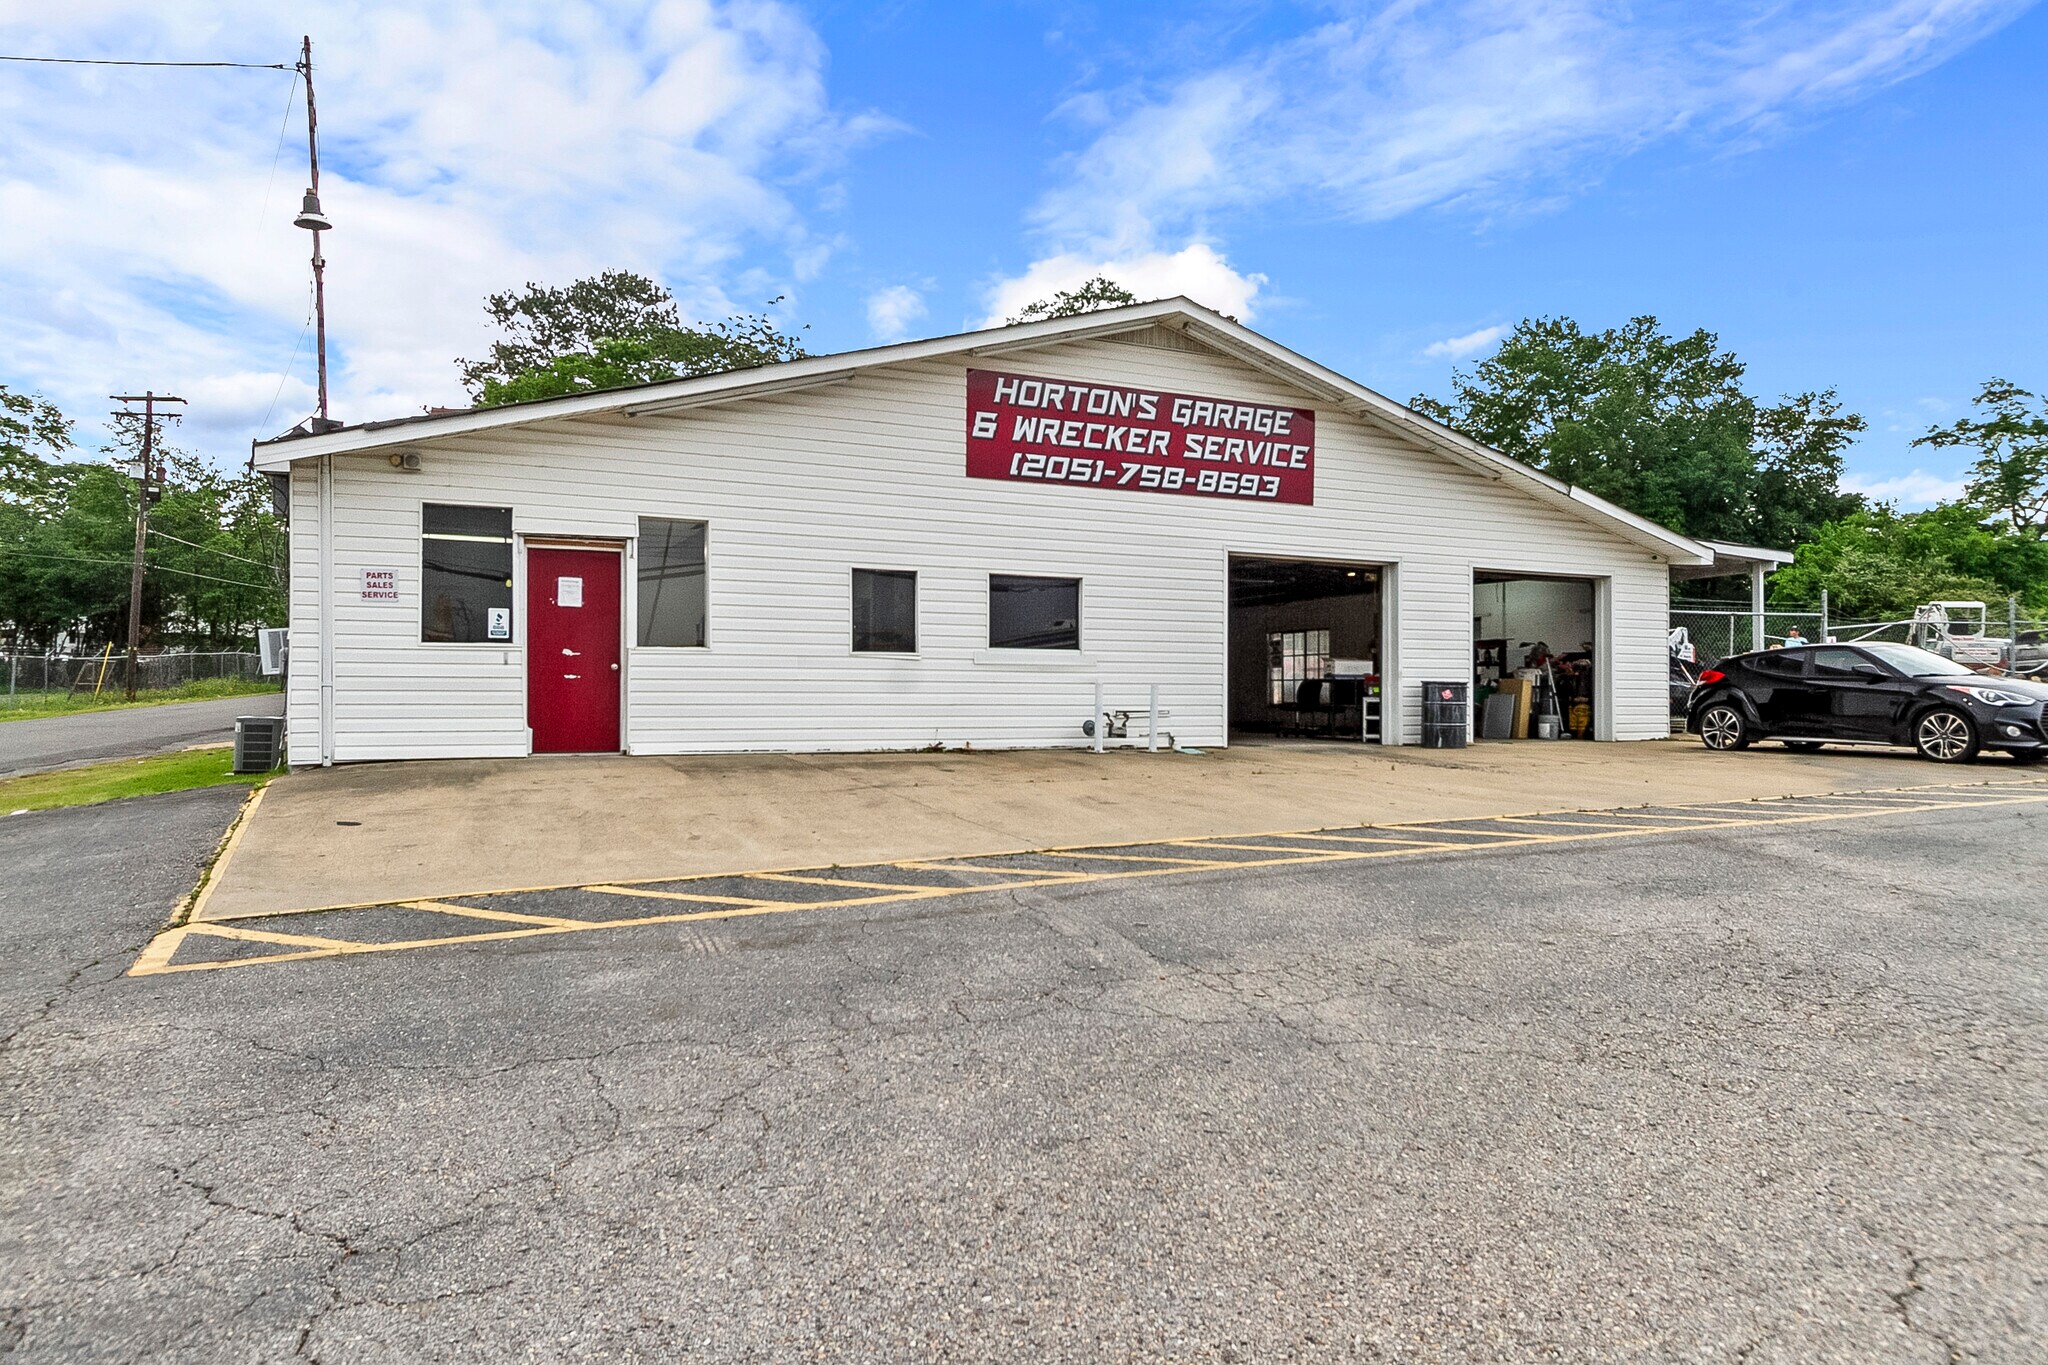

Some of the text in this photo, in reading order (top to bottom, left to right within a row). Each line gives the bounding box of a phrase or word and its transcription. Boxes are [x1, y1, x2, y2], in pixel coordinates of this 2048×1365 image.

[993, 377, 1294, 437] HORTON'S GARAGE
[1011, 415, 1171, 456] WRECKER
[1183, 433, 1310, 469] SERVICE
[1009, 452, 1281, 498] (205)-758-8693
[361, 591, 399, 599] SERVICE
[366, 581, 394, 589] SALES
